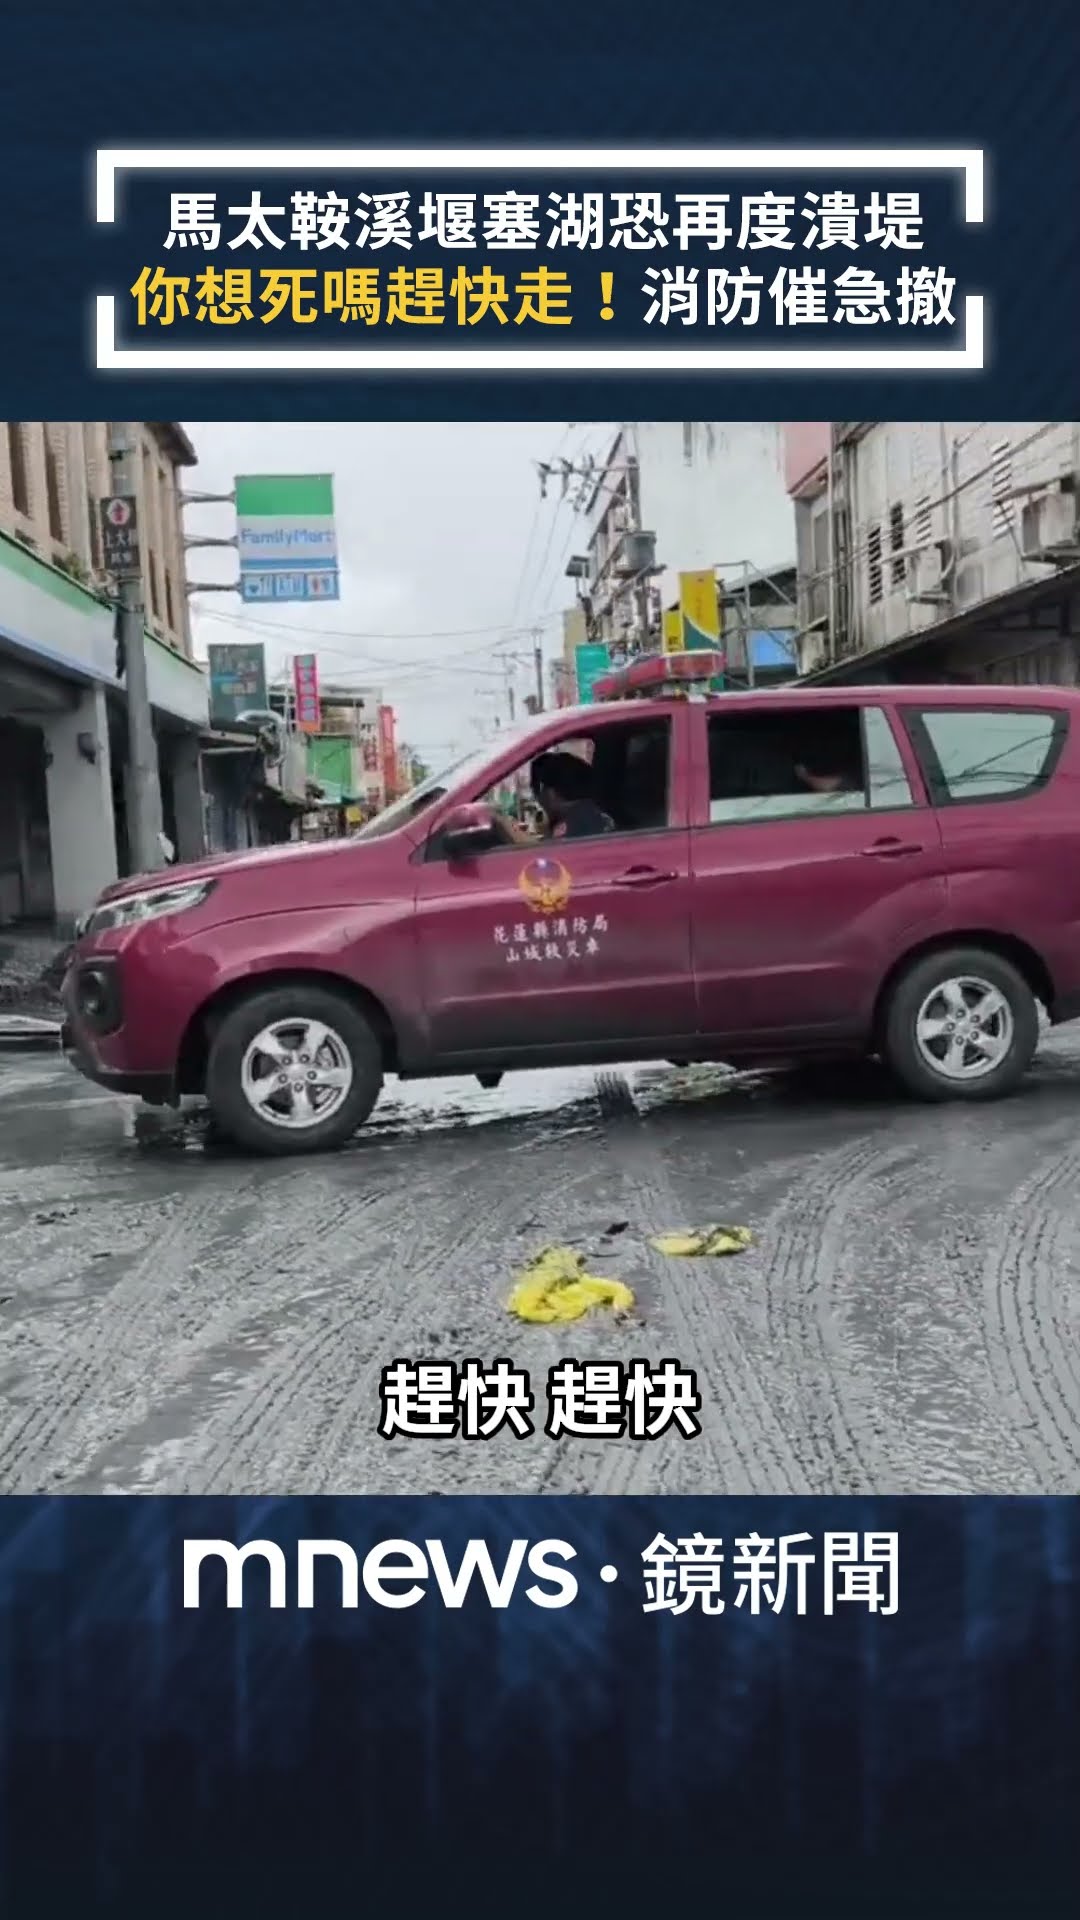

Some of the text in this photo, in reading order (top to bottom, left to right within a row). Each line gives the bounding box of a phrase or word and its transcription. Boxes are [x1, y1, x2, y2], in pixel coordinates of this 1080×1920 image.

[241, 528, 335, 548] FamilyMart
[494, 914, 608, 944] 花蓮縣消防局
[506, 937, 599, 963] 山城救災車
